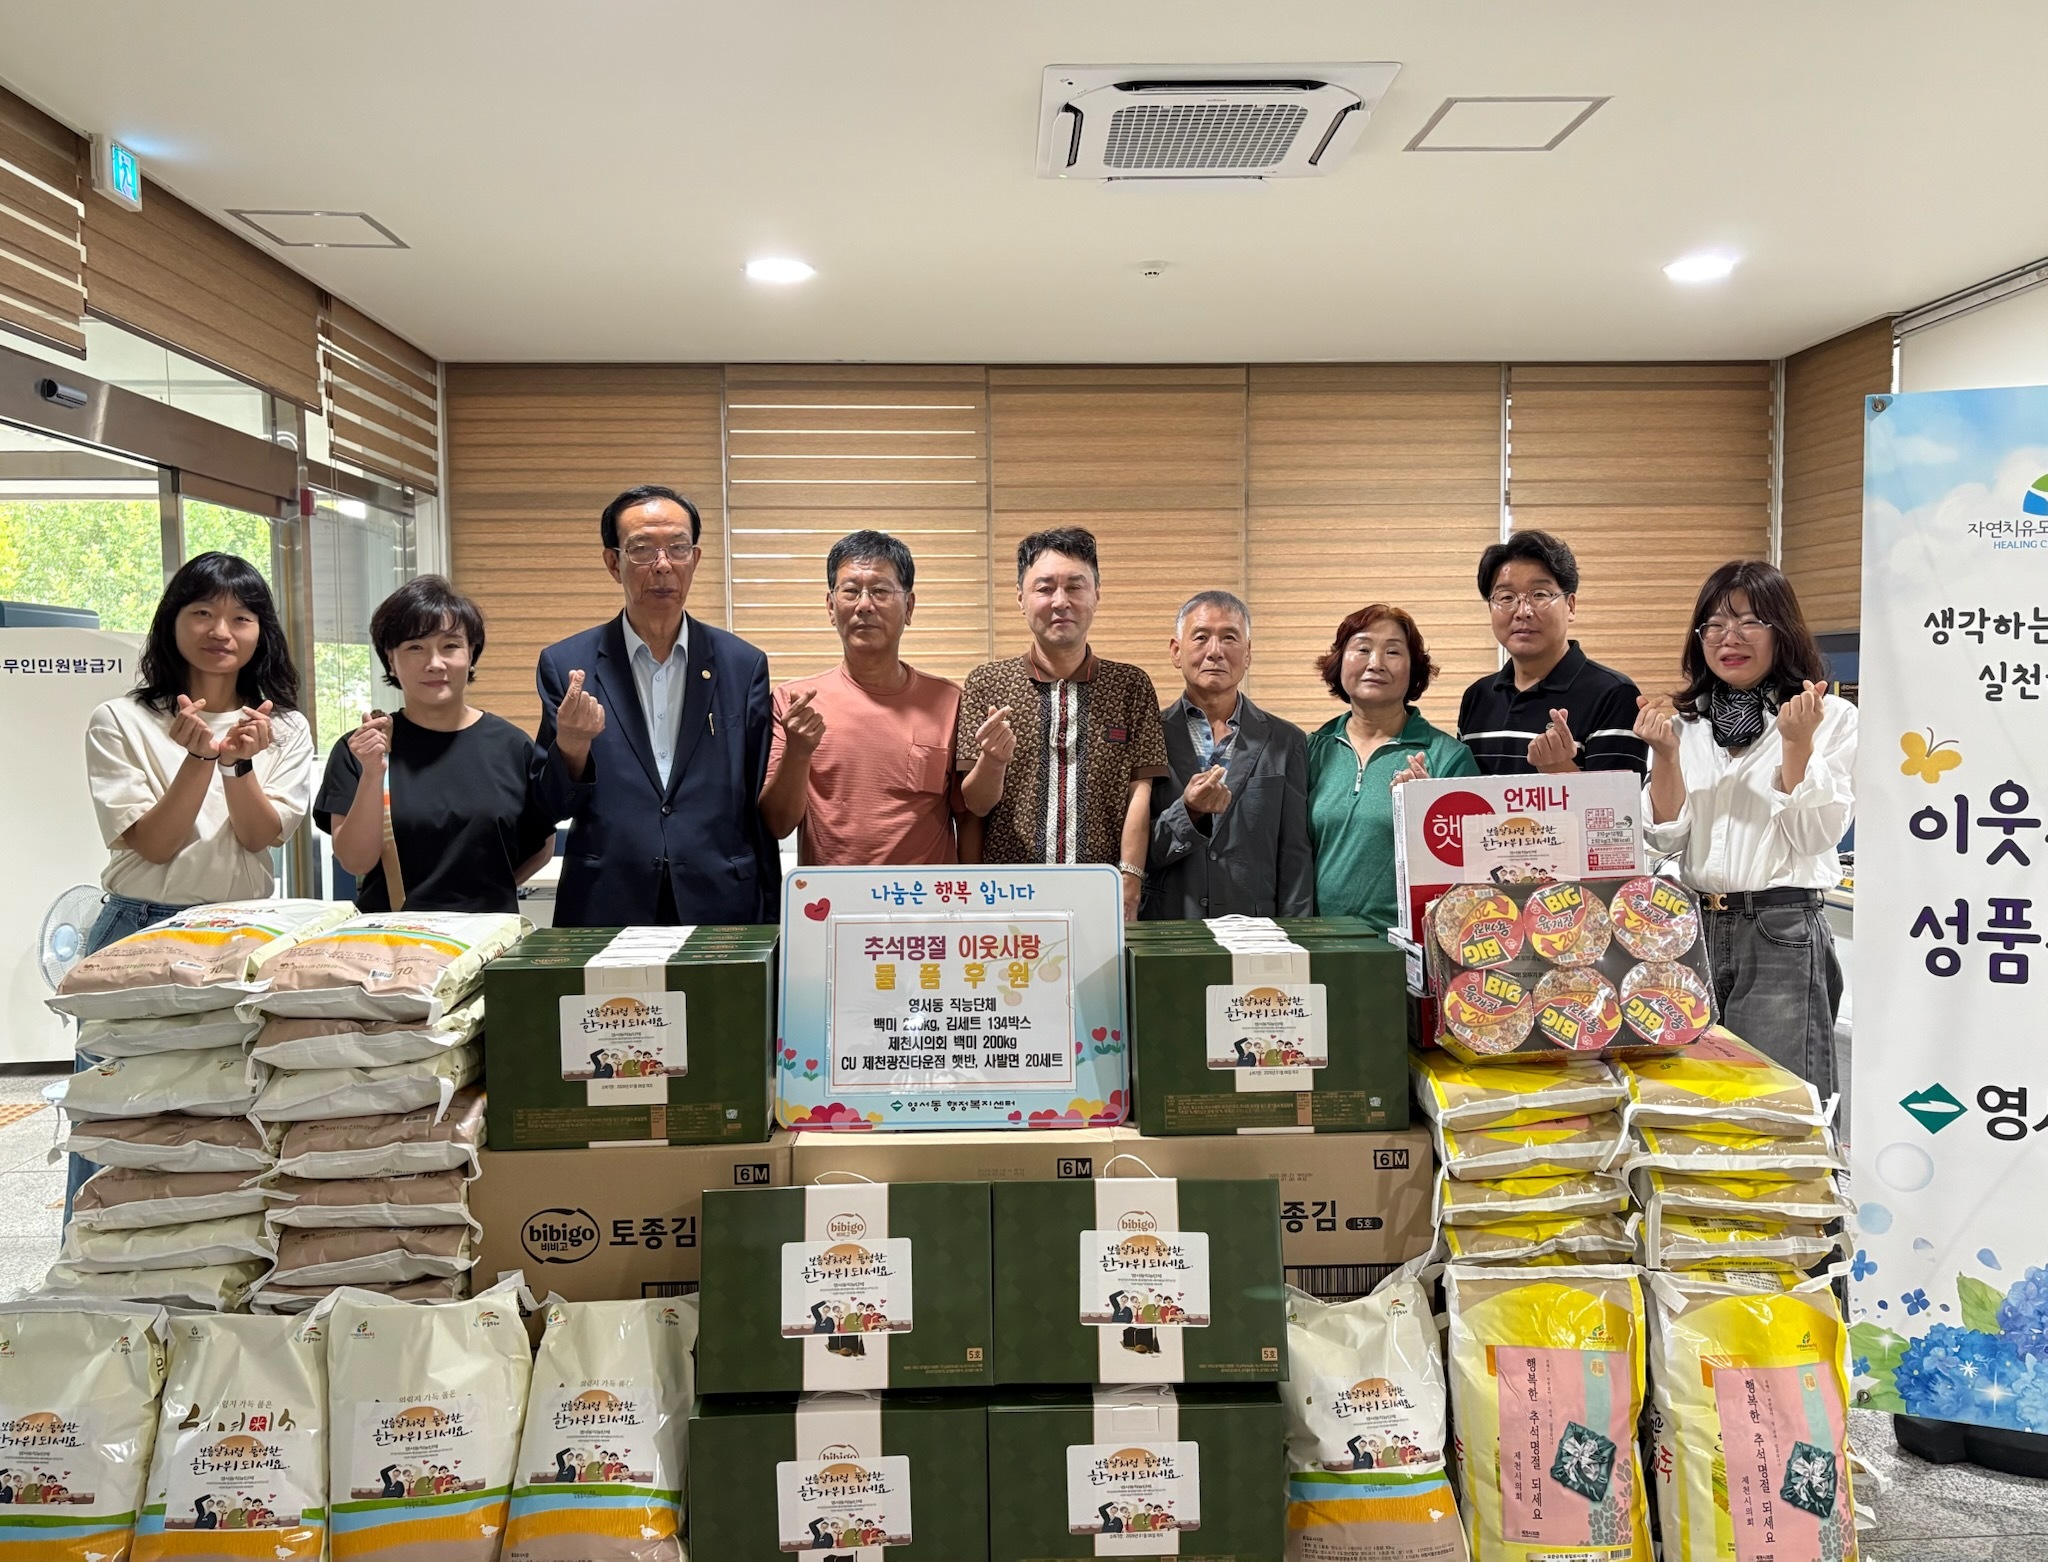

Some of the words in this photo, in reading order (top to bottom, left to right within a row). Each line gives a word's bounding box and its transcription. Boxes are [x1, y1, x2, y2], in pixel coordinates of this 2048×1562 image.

[1993, 540, 2033, 550] HEALING
[1924, 606, 2048, 645] 생각하는
[3, 659, 122, 674] 무인민원발급기
[1503, 785, 1570, 813] 언제나
[871, 882, 927, 905] 나눔은
[934, 880, 972, 904] 행복
[979, 880, 1035, 905] 입니다
[1544, 886, 1581, 914] BIG
[1651, 888, 1688, 916] BIG
[1473, 919, 1512, 938] 육개장
[1535, 911, 1574, 931] 육개장
[864, 935, 947, 961] 추석명절
[958, 934, 1041, 960] 이웃사랑
[1463, 939, 1501, 963] BIG
[1462, 984, 1499, 1014] 육개장
[1484, 975, 1522, 1003] BIG
[908, 998, 944, 1013] 영서동
[950, 997, 997, 1012] 직능단체
[1626, 999, 1664, 1031] BIG
[1653, 995, 1687, 1031] 육개장
[873, 1016, 897, 1032] 백미
[946, 1017, 981, 1031] 김세트
[988, 1016, 1032, 1031] 134박스
[1541, 1008, 1579, 1040] BIG
[888, 1035, 947, 1051] 제천시의회
[954, 1035, 977, 1050] 백미
[983, 1036, 1018, 1050] 200kg
[841, 1056, 857, 1071] CU
[862, 1054, 946, 1070] 제천광진타운점
[952, 1054, 979, 1070] 햇반,
[984, 1053, 1020, 1069] 사발면
[1025, 1052, 1063, 1068] 20세트
[907, 1100, 943, 1112] 영서동
[947, 1099, 1016, 1111] 행정복지센터
[1063, 1162, 1091, 1176] 6M
[1380, 1152, 1408, 1167] 6M
[740, 1166, 769, 1182] 6M
[529, 1223, 595, 1248] bibigo
[609, 1216, 696, 1250] 토종김
[830, 1221, 864, 1234] bibigo
[1121, 1219, 1155, 1232] bibigo
[1356, 1218, 1374, 1229] 5호
[540, 1242, 569, 1252] 비비고
[968, 1350, 981, 1360] 5호
[1263, 1350, 1276, 1359] 5호
[1526, 1357, 1539, 1402] 행복한
[1528, 1410, 1541, 1471] 추석명절
[1745, 1379, 1760, 1424] 행복한
[1753, 1432, 1771, 1494] 추석명절
[1762, 1500, 1776, 1544] 되세요
[1514, 1451, 1522, 1501] 제천시의회
[1531, 1477, 1543, 1520] 되세요
[1742, 1476, 1754, 1527] 제천시의회
